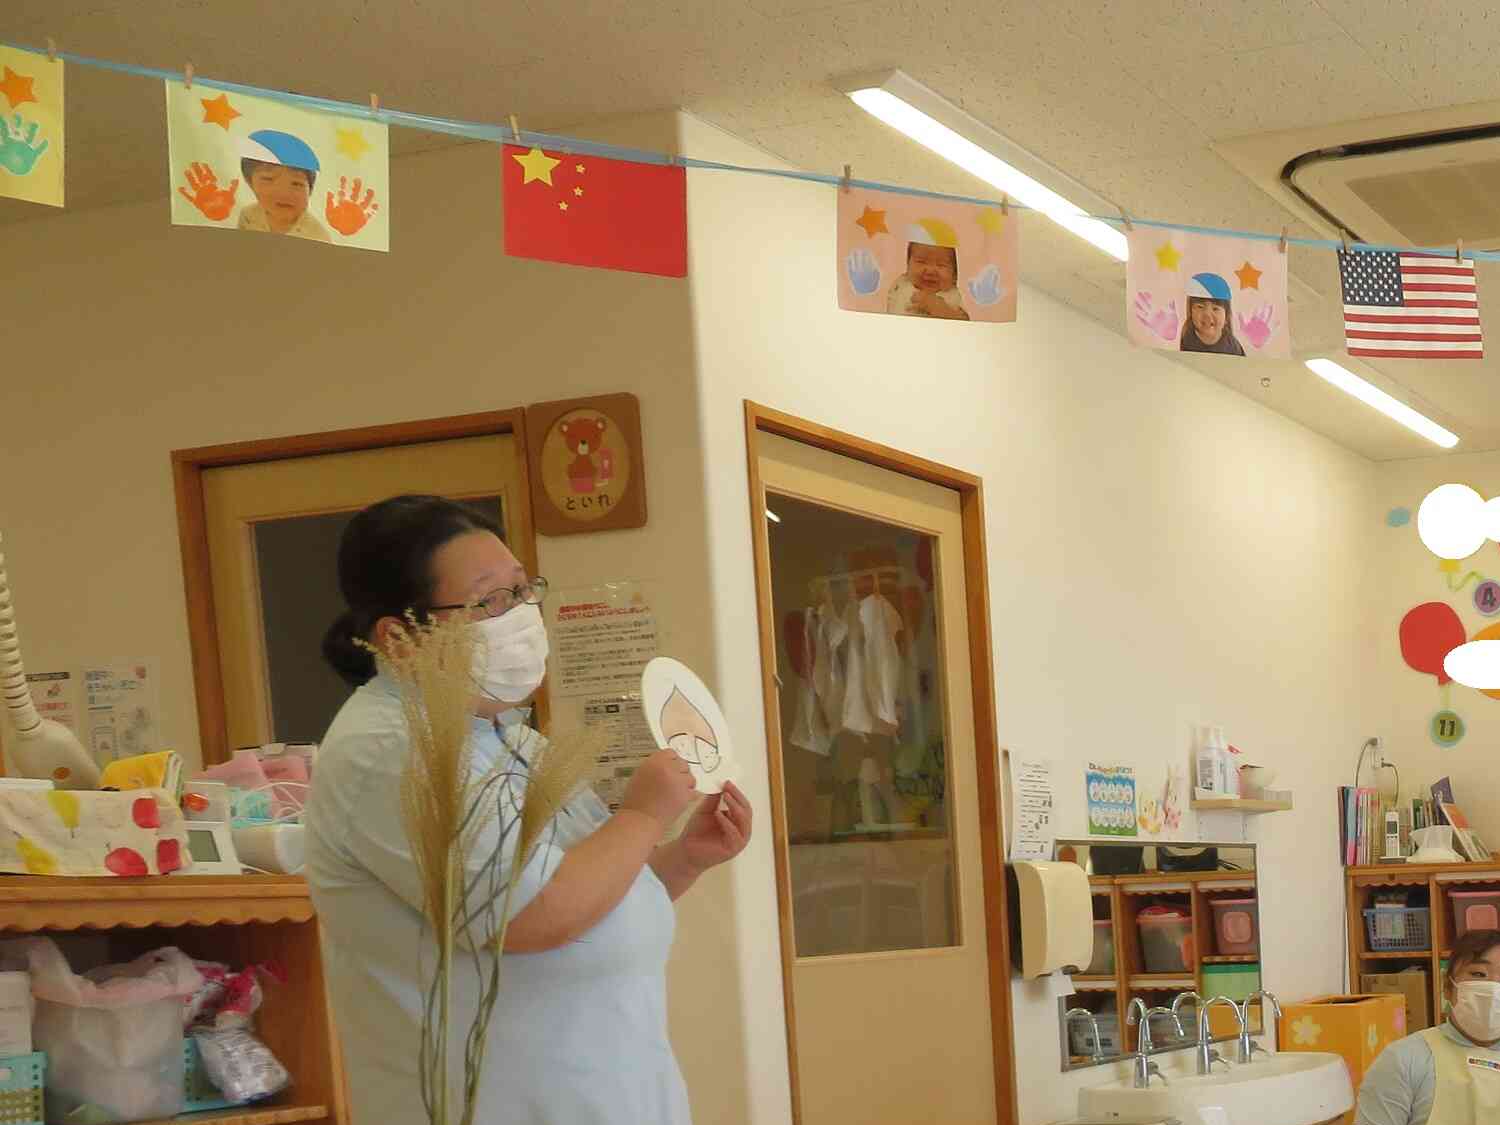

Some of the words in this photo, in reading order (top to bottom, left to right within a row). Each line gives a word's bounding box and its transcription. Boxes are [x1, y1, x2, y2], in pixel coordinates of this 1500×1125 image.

[566, 494, 616, 510] といれ
[1483, 586, 1497, 606] 4
[1439, 719, 1455, 737] 11
